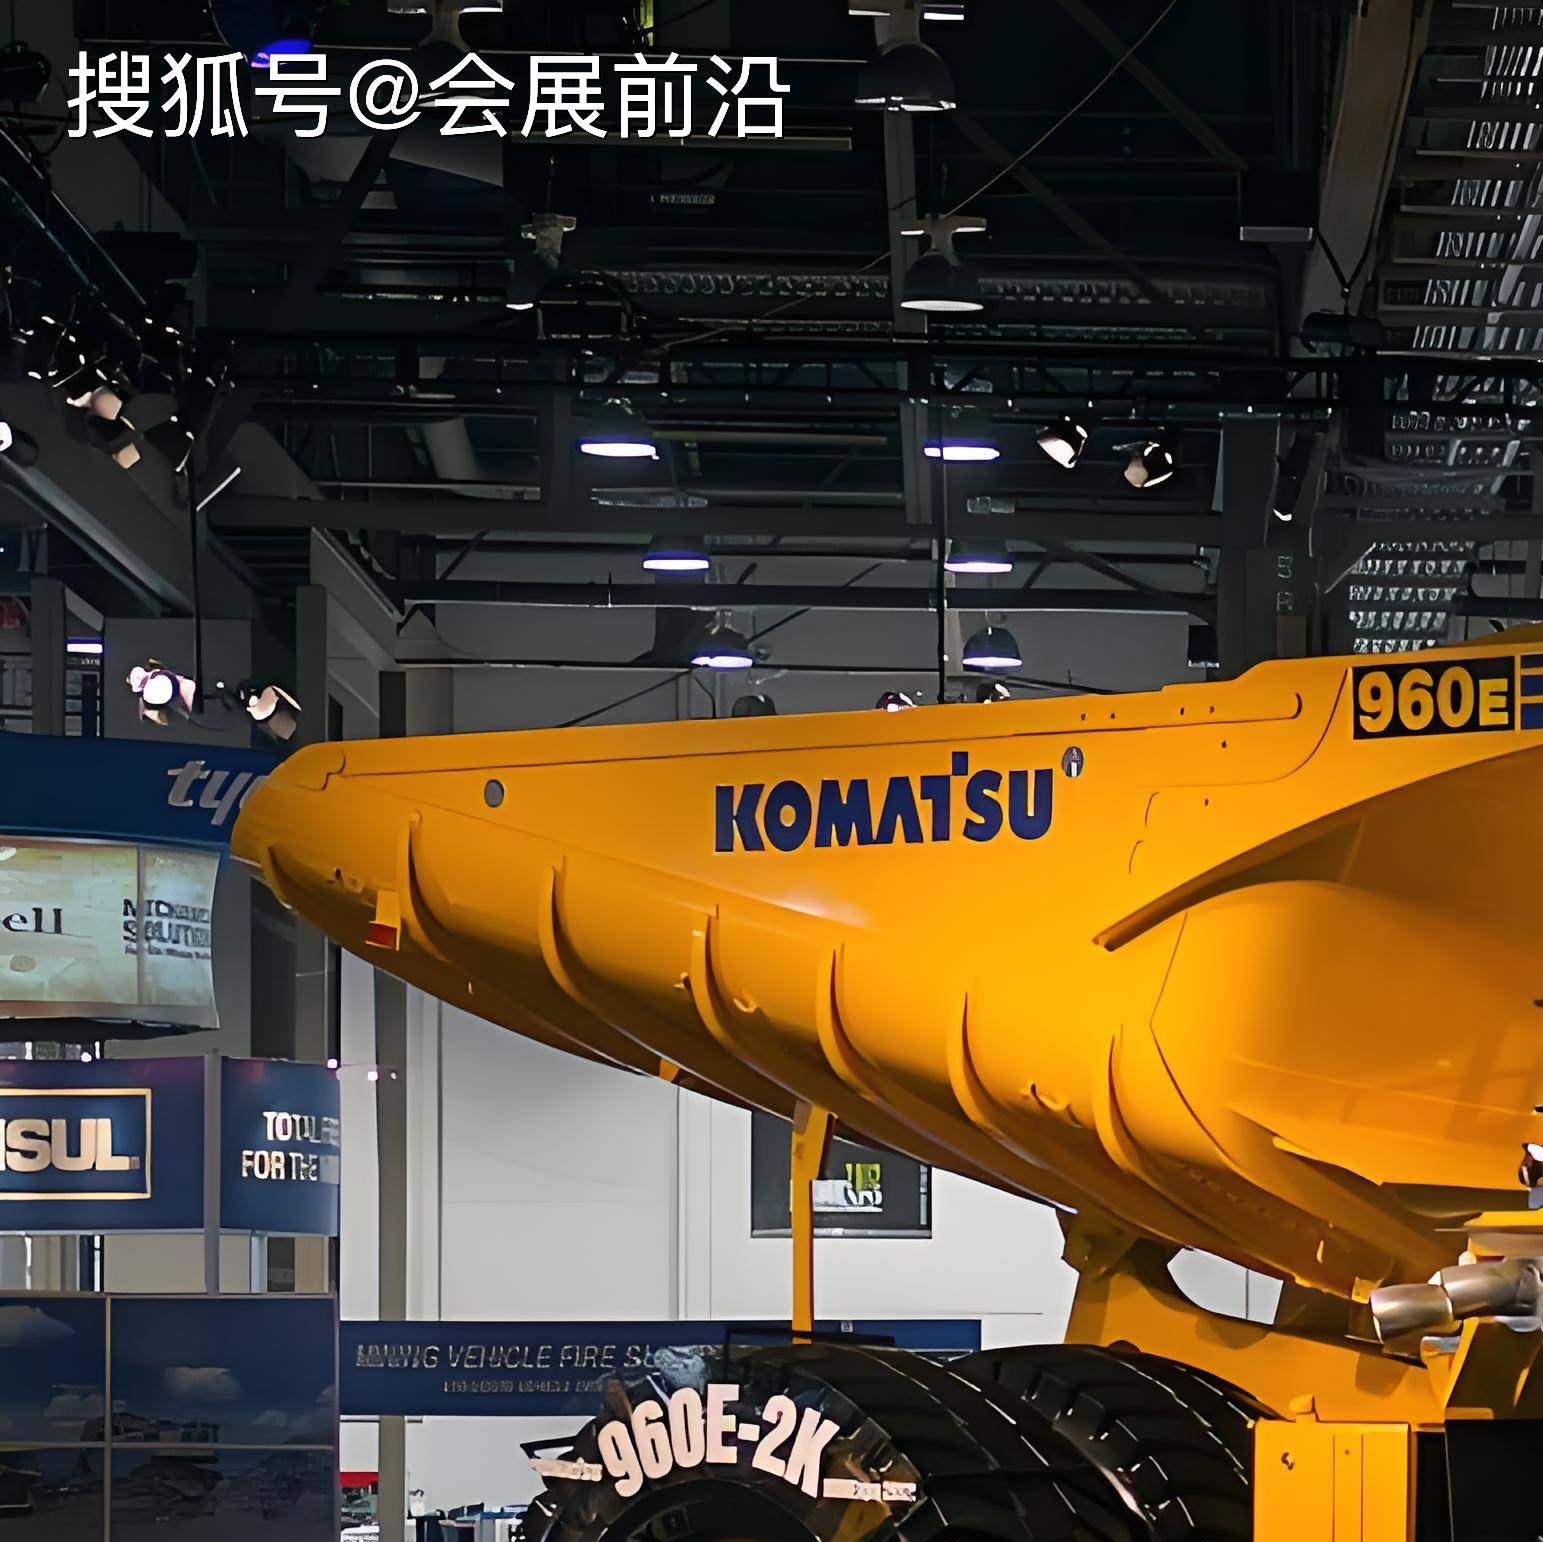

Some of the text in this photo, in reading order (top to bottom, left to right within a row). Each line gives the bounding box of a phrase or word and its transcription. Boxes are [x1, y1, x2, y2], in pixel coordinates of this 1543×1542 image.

[1358, 666, 1508, 733] 960E
[715, 751, 1053, 853] KOMATSU
[0, 1118, 130, 1173] SUL
[242, 1150, 285, 1180] FOR
[559, 1344, 616, 1369] FIRE
[598, 1383, 840, 1498] 960E-2K
